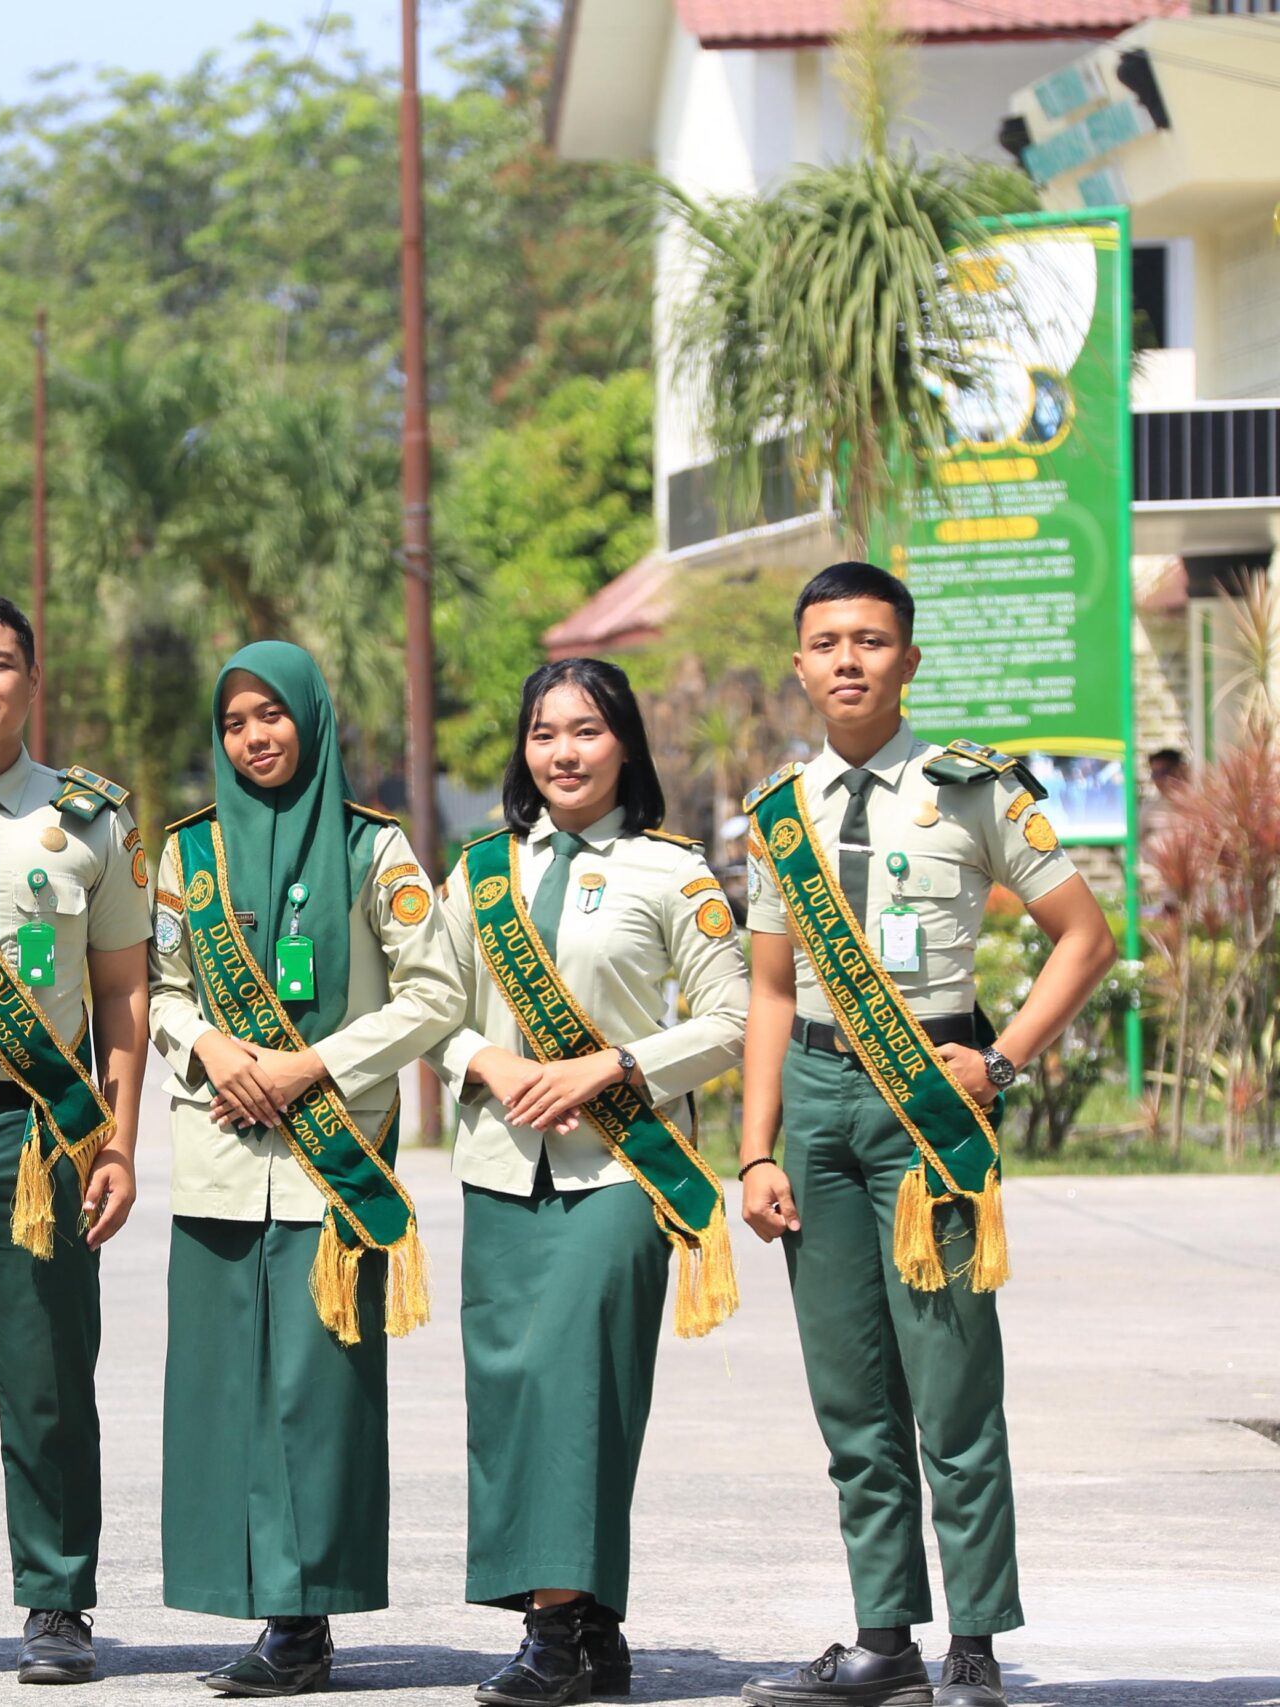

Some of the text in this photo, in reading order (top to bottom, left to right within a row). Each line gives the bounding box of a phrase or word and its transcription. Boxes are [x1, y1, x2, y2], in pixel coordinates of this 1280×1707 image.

[193, 928, 251, 1037] POLBANGTAN
[209, 920, 247, 984] DUTA
[481, 923, 541, 1027] POLBANGTAN
[534, 1026, 565, 1062] MED
[500, 917, 541, 979] DUTA
[530, 975, 583, 1048] PELITA
[781, 874, 836, 980] POLBANGTAN
[830, 974, 869, 1036] MEDAN
[862, 1034, 914, 1103] 2025/2026
[802, 873, 926, 1081] DUTA AGRIPRENEUR
